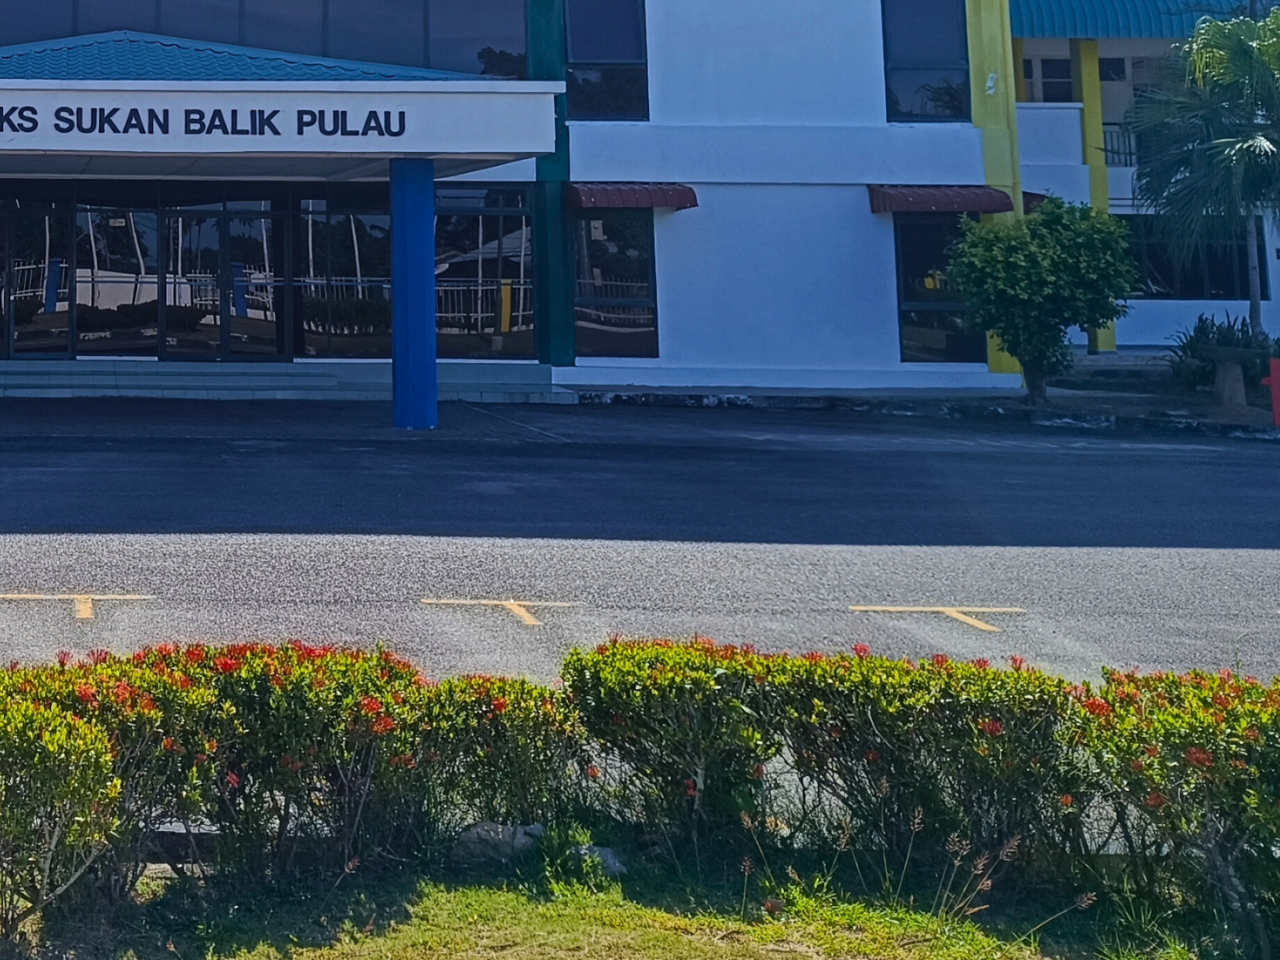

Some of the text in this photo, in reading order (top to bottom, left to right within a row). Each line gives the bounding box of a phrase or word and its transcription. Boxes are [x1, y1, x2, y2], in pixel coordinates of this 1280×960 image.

[53, 106, 170, 135] SUKAN
[184, 108, 282, 136] BALIK
[296, 109, 406, 138] PULAU
